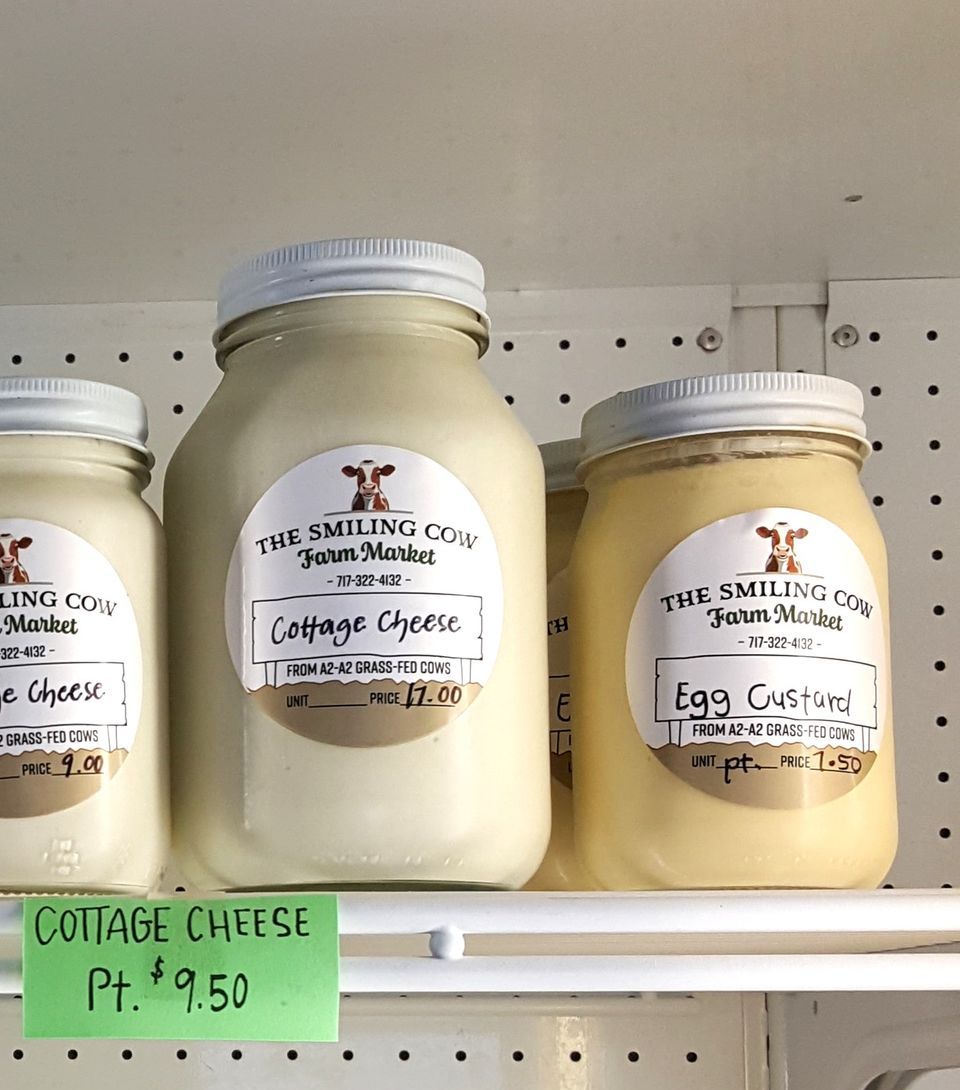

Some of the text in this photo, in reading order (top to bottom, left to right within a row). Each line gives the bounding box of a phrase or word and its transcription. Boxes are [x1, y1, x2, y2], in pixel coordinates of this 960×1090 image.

[255, 519, 479, 555] THE SMILING COW
[297, 542, 436, 570] Farm Market
[337, 574, 402, 587] 717-322-4132
[66, 592, 117, 617] COW
[660, 581, 874, 619] THE SMILING COW
[4, 614, 78, 635] Market
[271, 610, 461, 647] Cottage Cheese
[707, 604, 844, 631] Farm Market
[748, 636, 813, 650] 717-322-4132
[287, 660, 451, 677] FROM A2-A2 GRASS-FED COWS
[28, 677, 105, 708] Cheese
[286, 682, 462, 710] UNIT PRICE 17.00
[675, 681, 851, 719] Egg Custard
[6, 730, 99, 747] GRASS-FED COWS
[766, 723, 855, 742] GRASS-FED COWS
[22, 754, 103, 778] PRICE 9.00
[780, 755, 810, 769] PRICE
[34, 905, 310, 945] COTTAGE CHEESE
[88, 967, 139, 1013] Pt.
